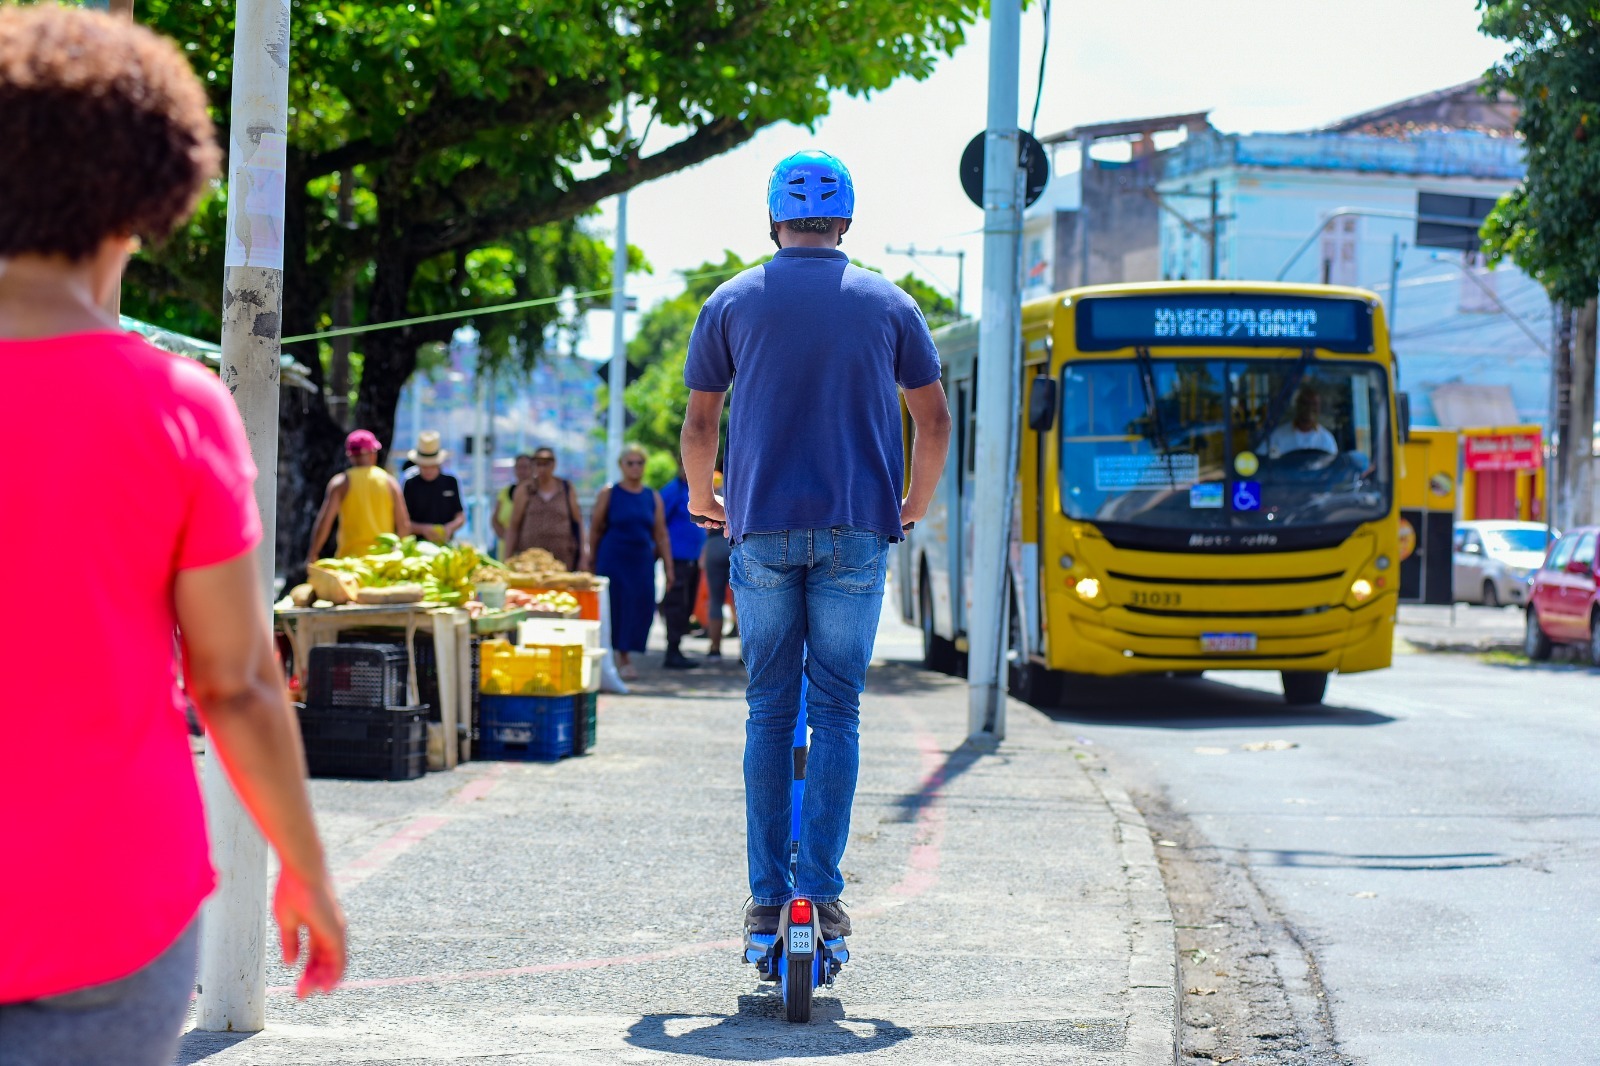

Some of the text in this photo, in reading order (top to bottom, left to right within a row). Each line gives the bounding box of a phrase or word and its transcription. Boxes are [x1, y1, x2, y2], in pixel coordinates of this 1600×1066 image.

[1227, 308, 1256, 323] DA
[1258, 308, 1318, 324] GAMA
[1155, 322, 1224, 336] DIQUE
[1131, 590, 1182, 607] 31033
[793, 931, 809, 939] 298
[793, 941, 809, 949] 328
